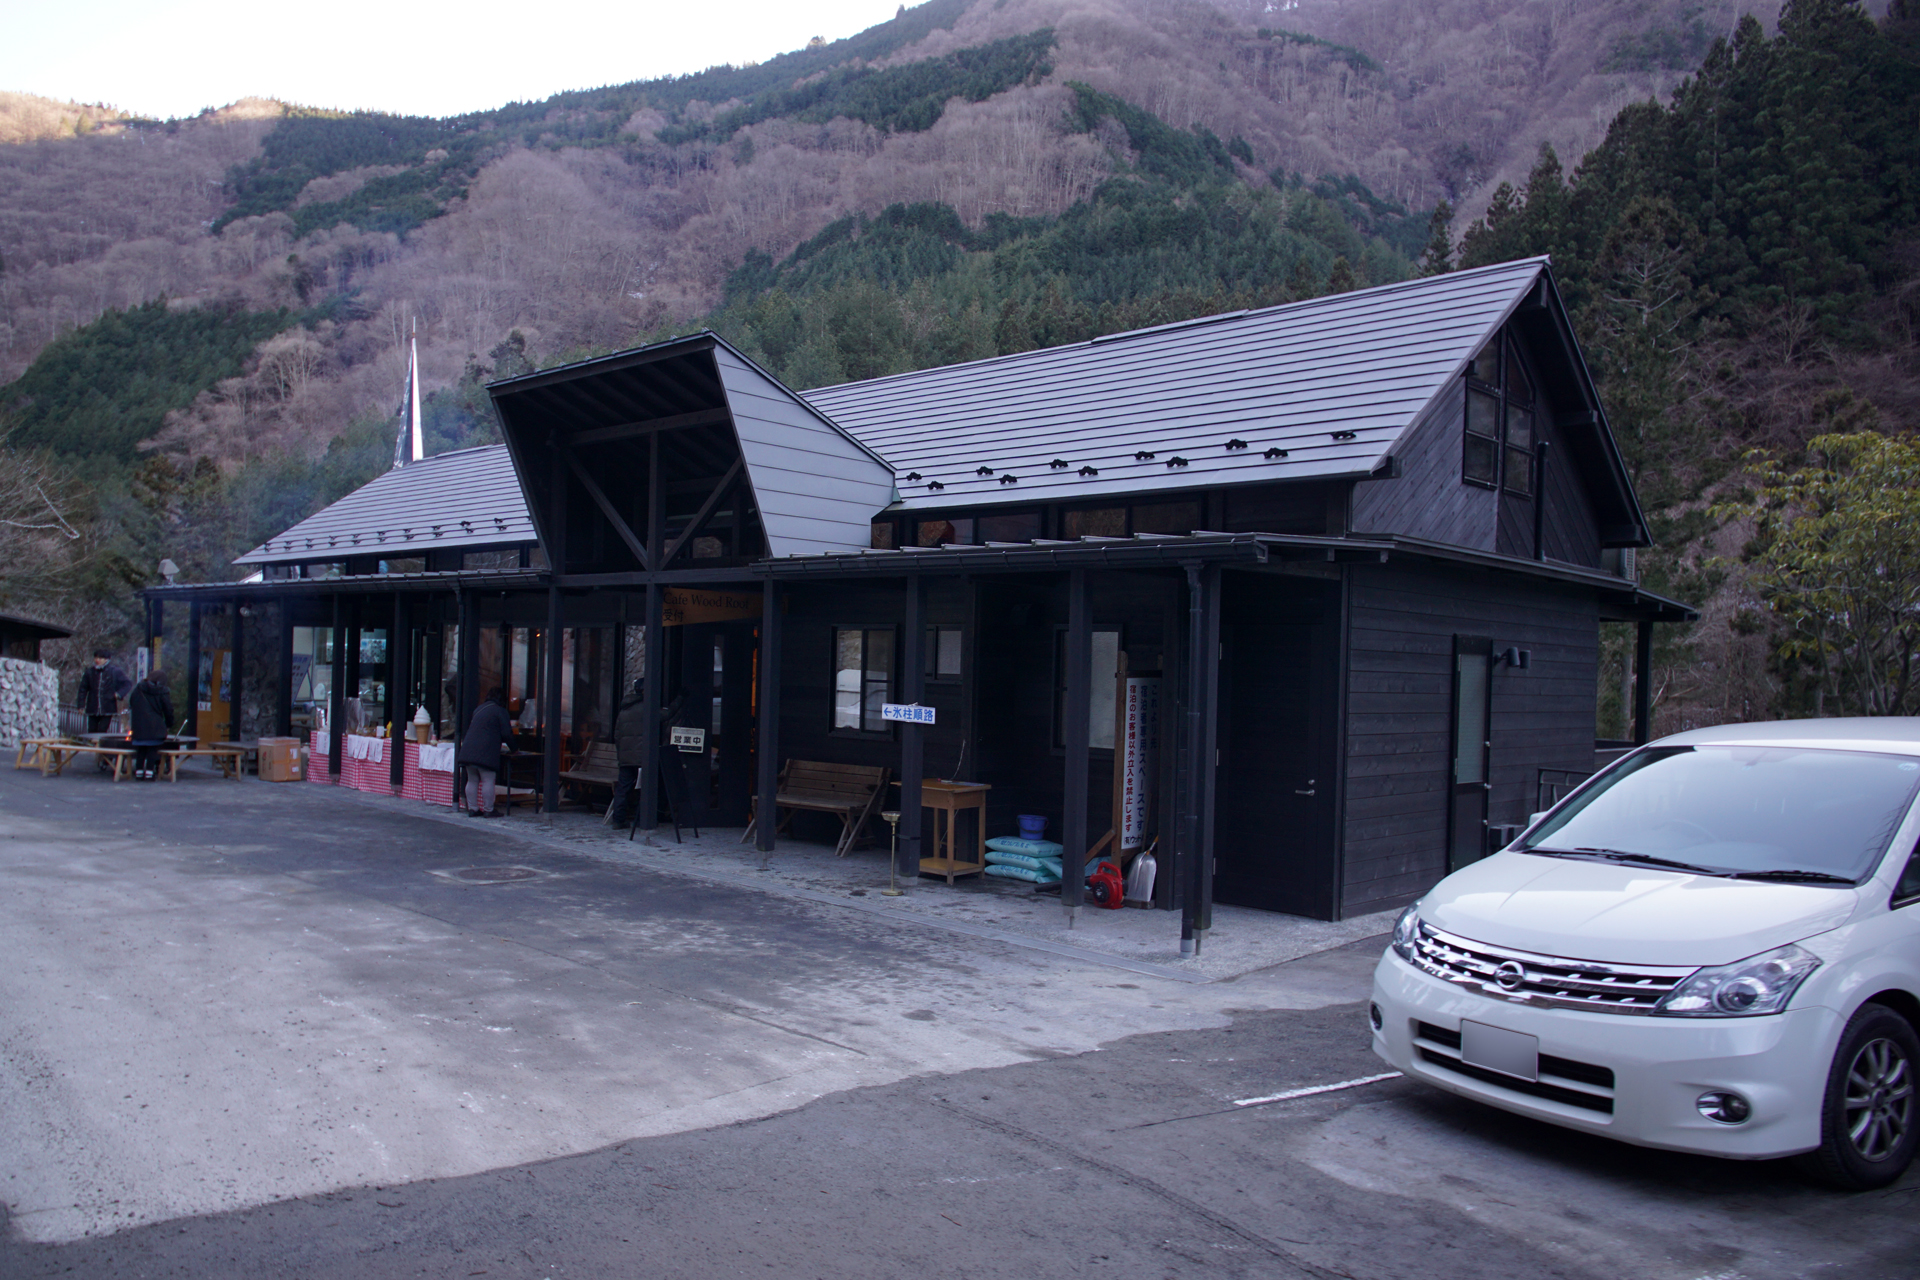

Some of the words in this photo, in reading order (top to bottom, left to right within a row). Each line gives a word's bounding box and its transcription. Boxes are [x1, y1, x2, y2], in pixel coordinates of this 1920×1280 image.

[663, 592, 688, 605] Cafe
[692, 594, 722, 607] Wood
[663, 608, 684, 622] 受付
[893, 707, 933, 721] 氷柱順路
[674, 735, 701, 745] 営業中
[1125, 684, 1137, 832] 宿泊のお客様以外立入を禁止します
